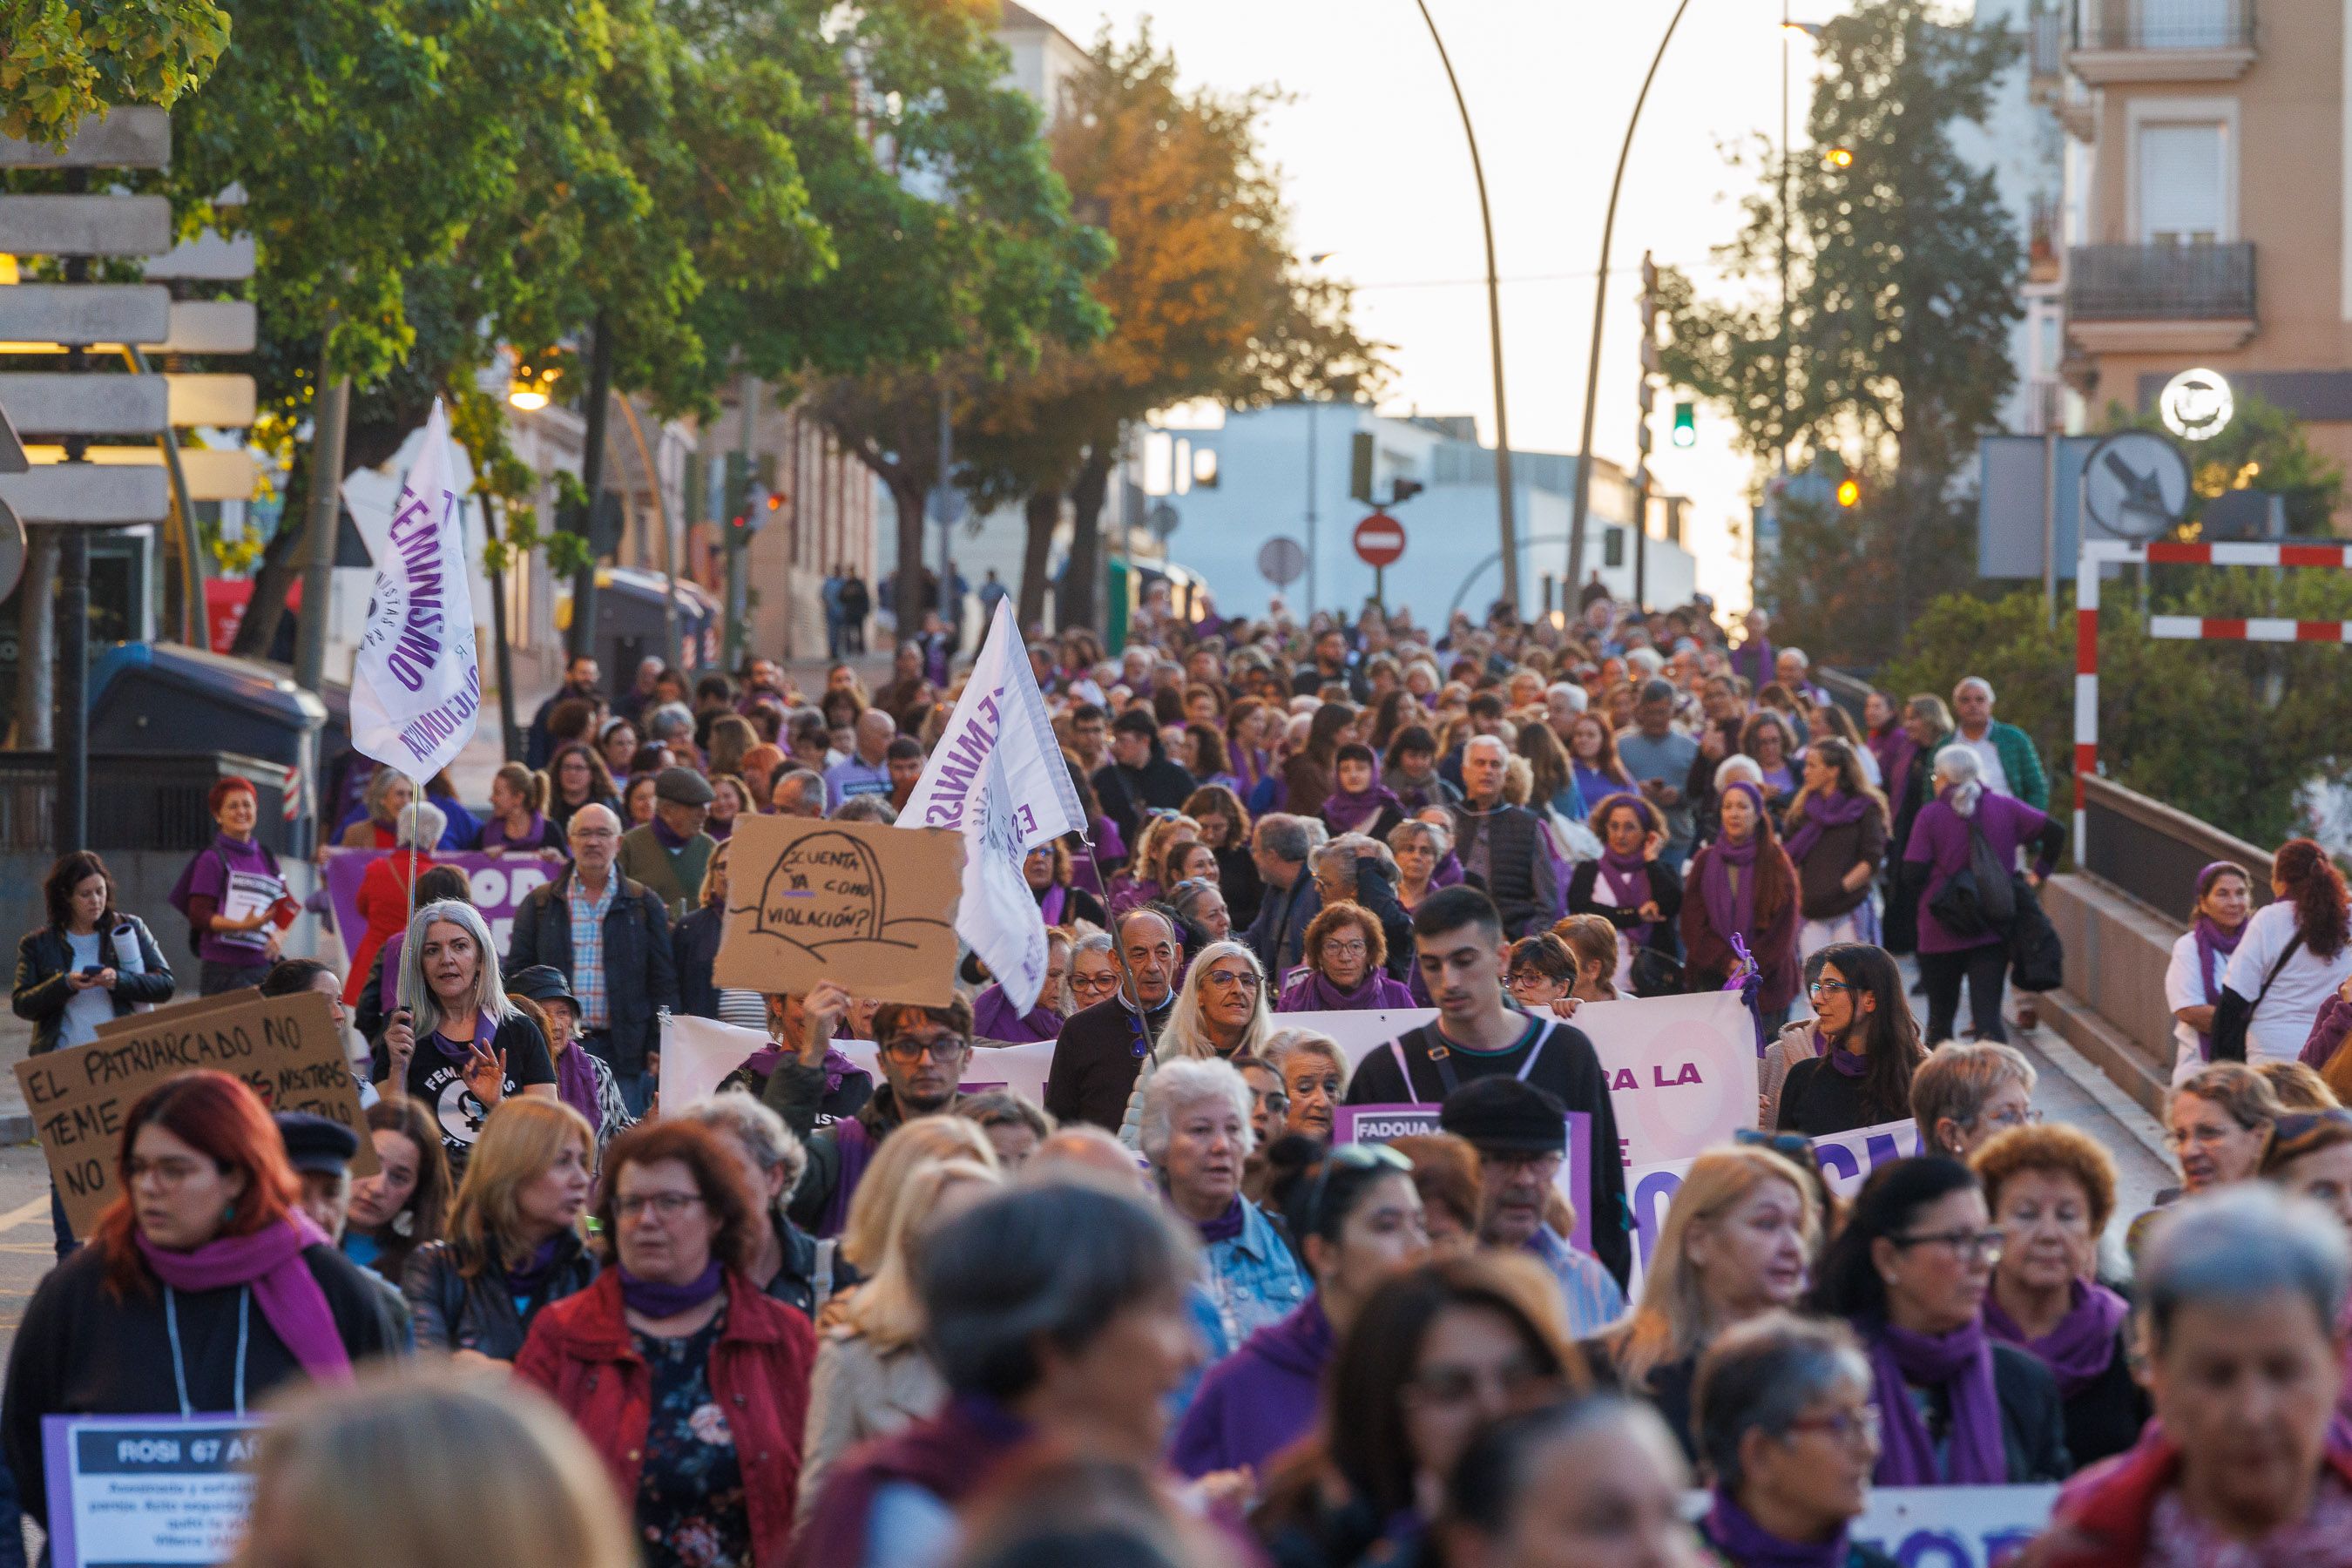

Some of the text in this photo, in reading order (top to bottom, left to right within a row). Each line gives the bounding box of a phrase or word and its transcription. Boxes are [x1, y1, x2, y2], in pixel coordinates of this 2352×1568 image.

[790, 873, 871, 896] YA COMO
[767, 906, 869, 935] VIOLACIÓN?
[28, 1017, 301, 1103] EL PATRIARCADO NO
[1653, 1063, 1703, 1087] LA
[43, 1098, 125, 1146] TEME
[1359, 1121, 1429, 1138] FADOUA
[64, 1159, 105, 1196] NO
[118, 1439, 180, 1463] ROSI
[191, 1439, 220, 1463] 67
